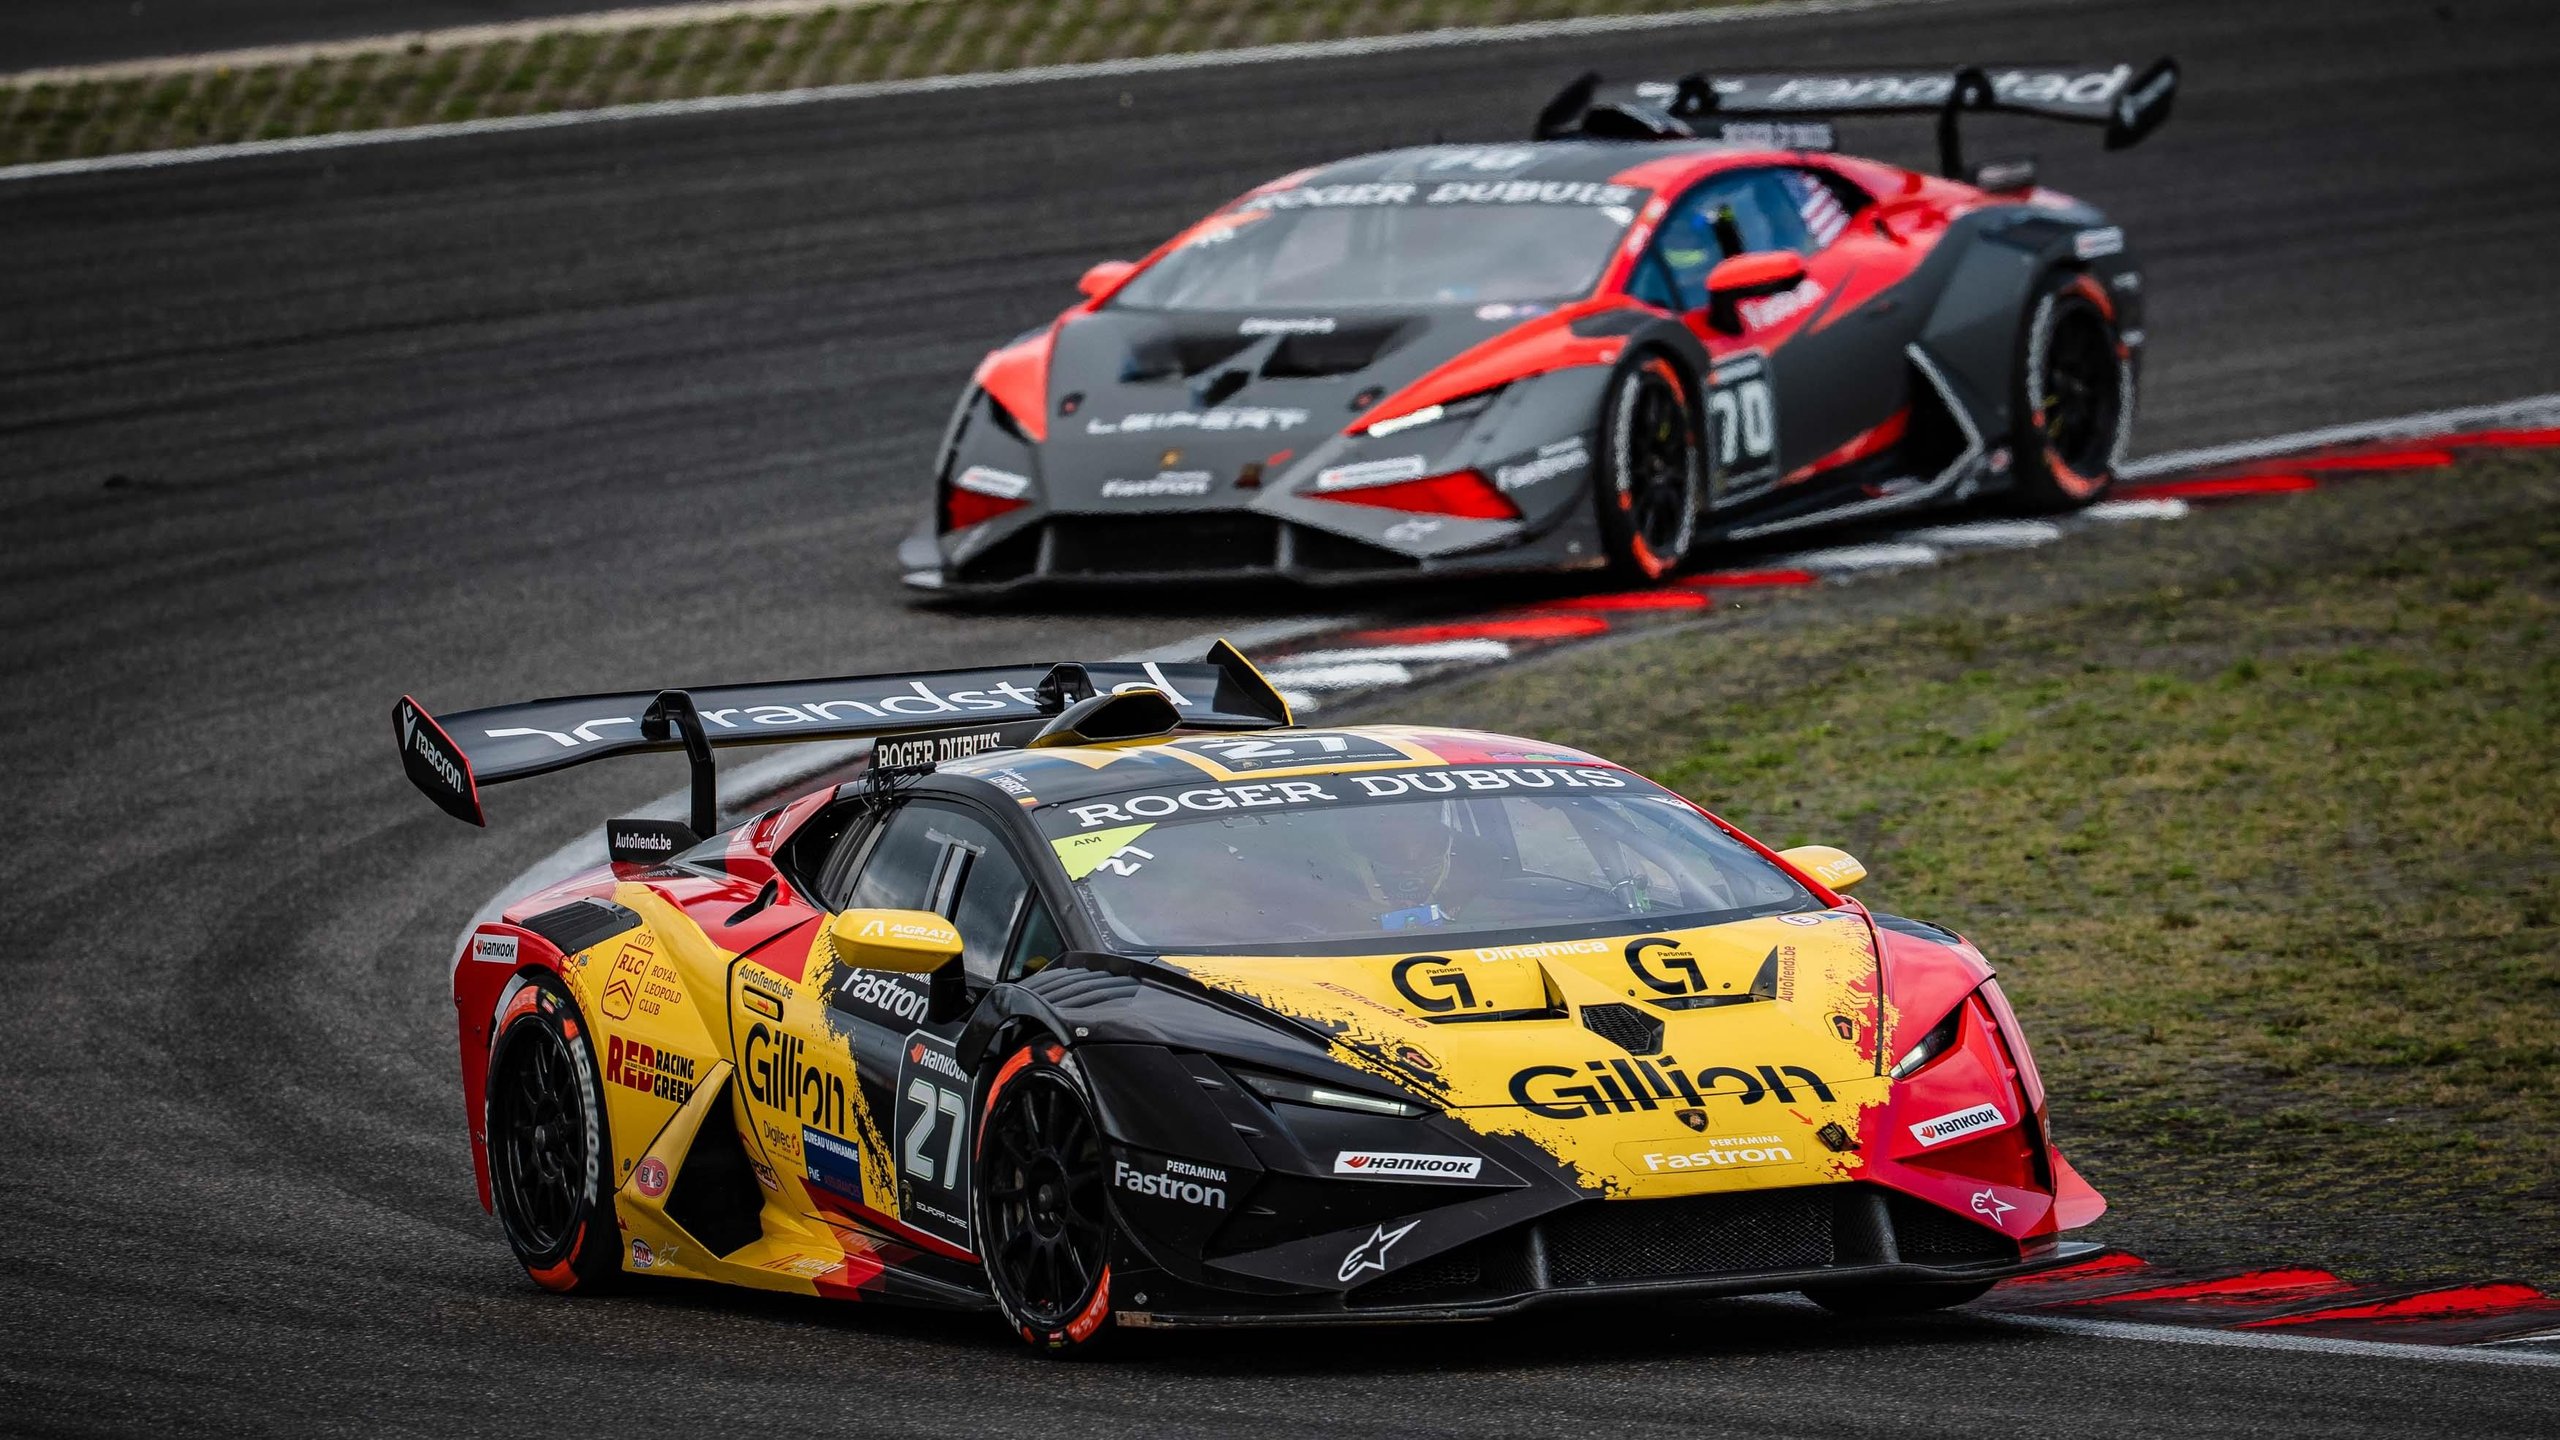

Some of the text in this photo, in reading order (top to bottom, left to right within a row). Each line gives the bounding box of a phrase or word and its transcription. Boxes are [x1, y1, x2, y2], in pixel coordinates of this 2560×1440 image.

[1427, 180, 1635, 205] DUBUIS
[1708, 380, 1774, 464] 70
[698, 662, 1193, 728] randstd
[415, 729, 462, 793] macron
[878, 740, 935, 768] ROGER
[1067, 768, 1626, 828] ROGER DUBUIS
[615, 832, 672, 850] AutoTrends.be
[1074, 836, 1102, 847] AM
[889, 923, 955, 940] AGRATI
[618, 954, 645, 975] RLC
[1475, 941, 1610, 963] Dinamica
[651, 965, 677, 984] ROYAL
[738, 963, 793, 999] AutoTrends.be
[1426, 967, 1463, 975] Partners
[1778, 945, 1796, 1002] AutoTrends.be
[644, 981, 682, 1004] LEOPOLD
[840, 968, 929, 1024] Fastron
[1314, 982, 1428, 1029] AutoTrends.be
[639, 998, 661, 1016] CLUB
[606, 1034, 655, 1093] RED
[655, 1049, 695, 1080] RACING
[654, 1073, 693, 1106] GREEN
[745, 1022, 845, 1135] Gillion
[1508, 1055, 1837, 1119] Gillion
[764, 1120, 791, 1148] Digitec
[803, 1129, 825, 1149] BUREAU
[905, 1078, 966, 1190] 27
[1709, 1133, 1783, 1147] PERTAMINA
[1166, 1159, 1227, 1182] PERTAMINA
[1643, 1146, 1792, 1171] Fastron
[1114, 1160, 1226, 1210] Fastron
